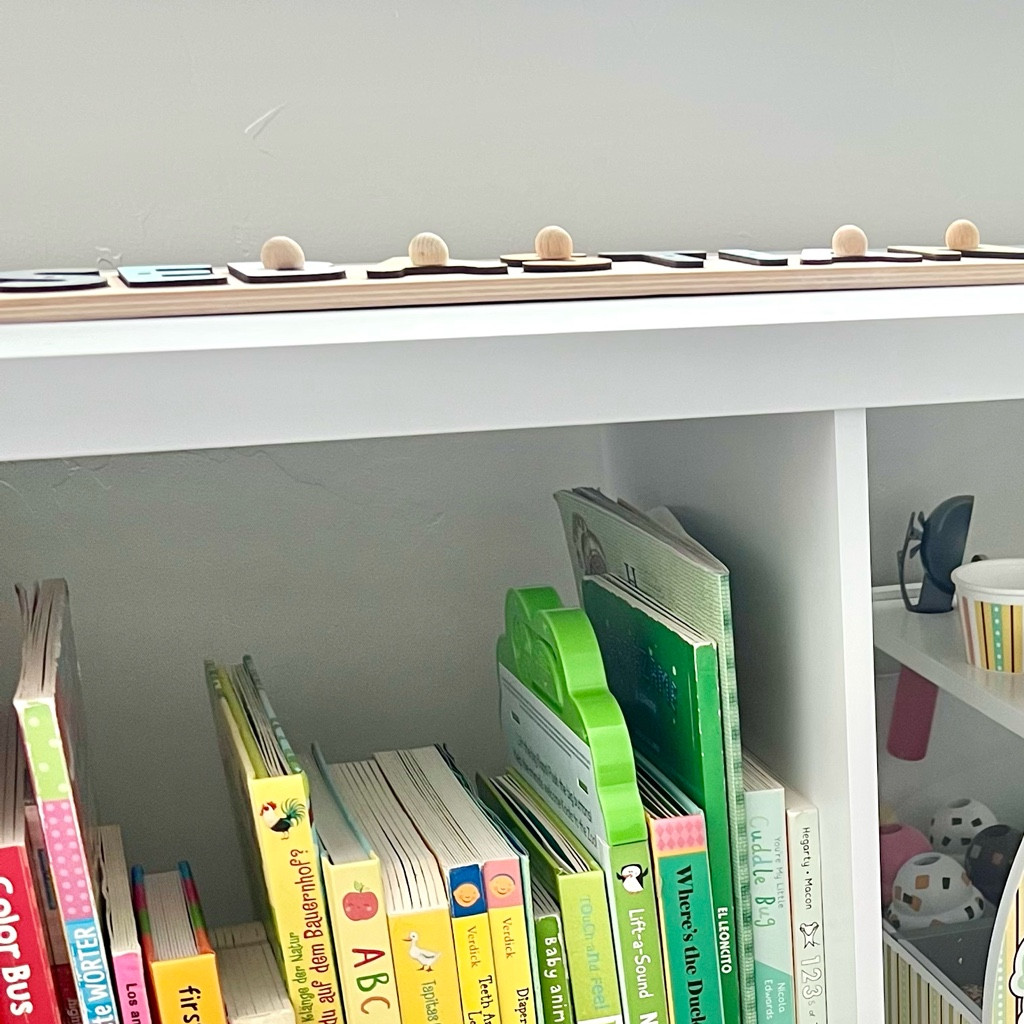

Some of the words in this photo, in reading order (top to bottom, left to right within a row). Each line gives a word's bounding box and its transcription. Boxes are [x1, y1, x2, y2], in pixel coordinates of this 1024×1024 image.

[749, 816, 773, 885] Cuddle
[800, 827, 813, 868] Hegarty
[290, 849, 324, 940] Bauernhof?
[676, 865, 698, 942] Where's
[717, 907, 728, 919] EL
[753, 896, 776, 927] Bug
[805, 877, 813, 910] Macon
[289, 932, 302, 963] Natur
[309, 940, 330, 973] dem
[467, 925, 479, 968] Verdick
[502, 917, 516, 959] Verdick
[544, 936, 561, 979] Baby
[628, 909, 654, 999] Lift-a-Sound
[718, 920, 732, 974] LEONCITO
[74, 926, 106, 1003] WÖRTER
[295, 965, 307, 985] der
[683, 946, 700, 975] the
[126, 983, 138, 1006] Los
[301, 986, 316, 1023] Klänge
[311, 981, 335, 1004] auf
[420, 980, 438, 1023] Tapitas
[479, 975, 493, 1009] Teeth
[764, 979, 775, 1020] Edwards
[778, 982, 786, 1013] Nicola
